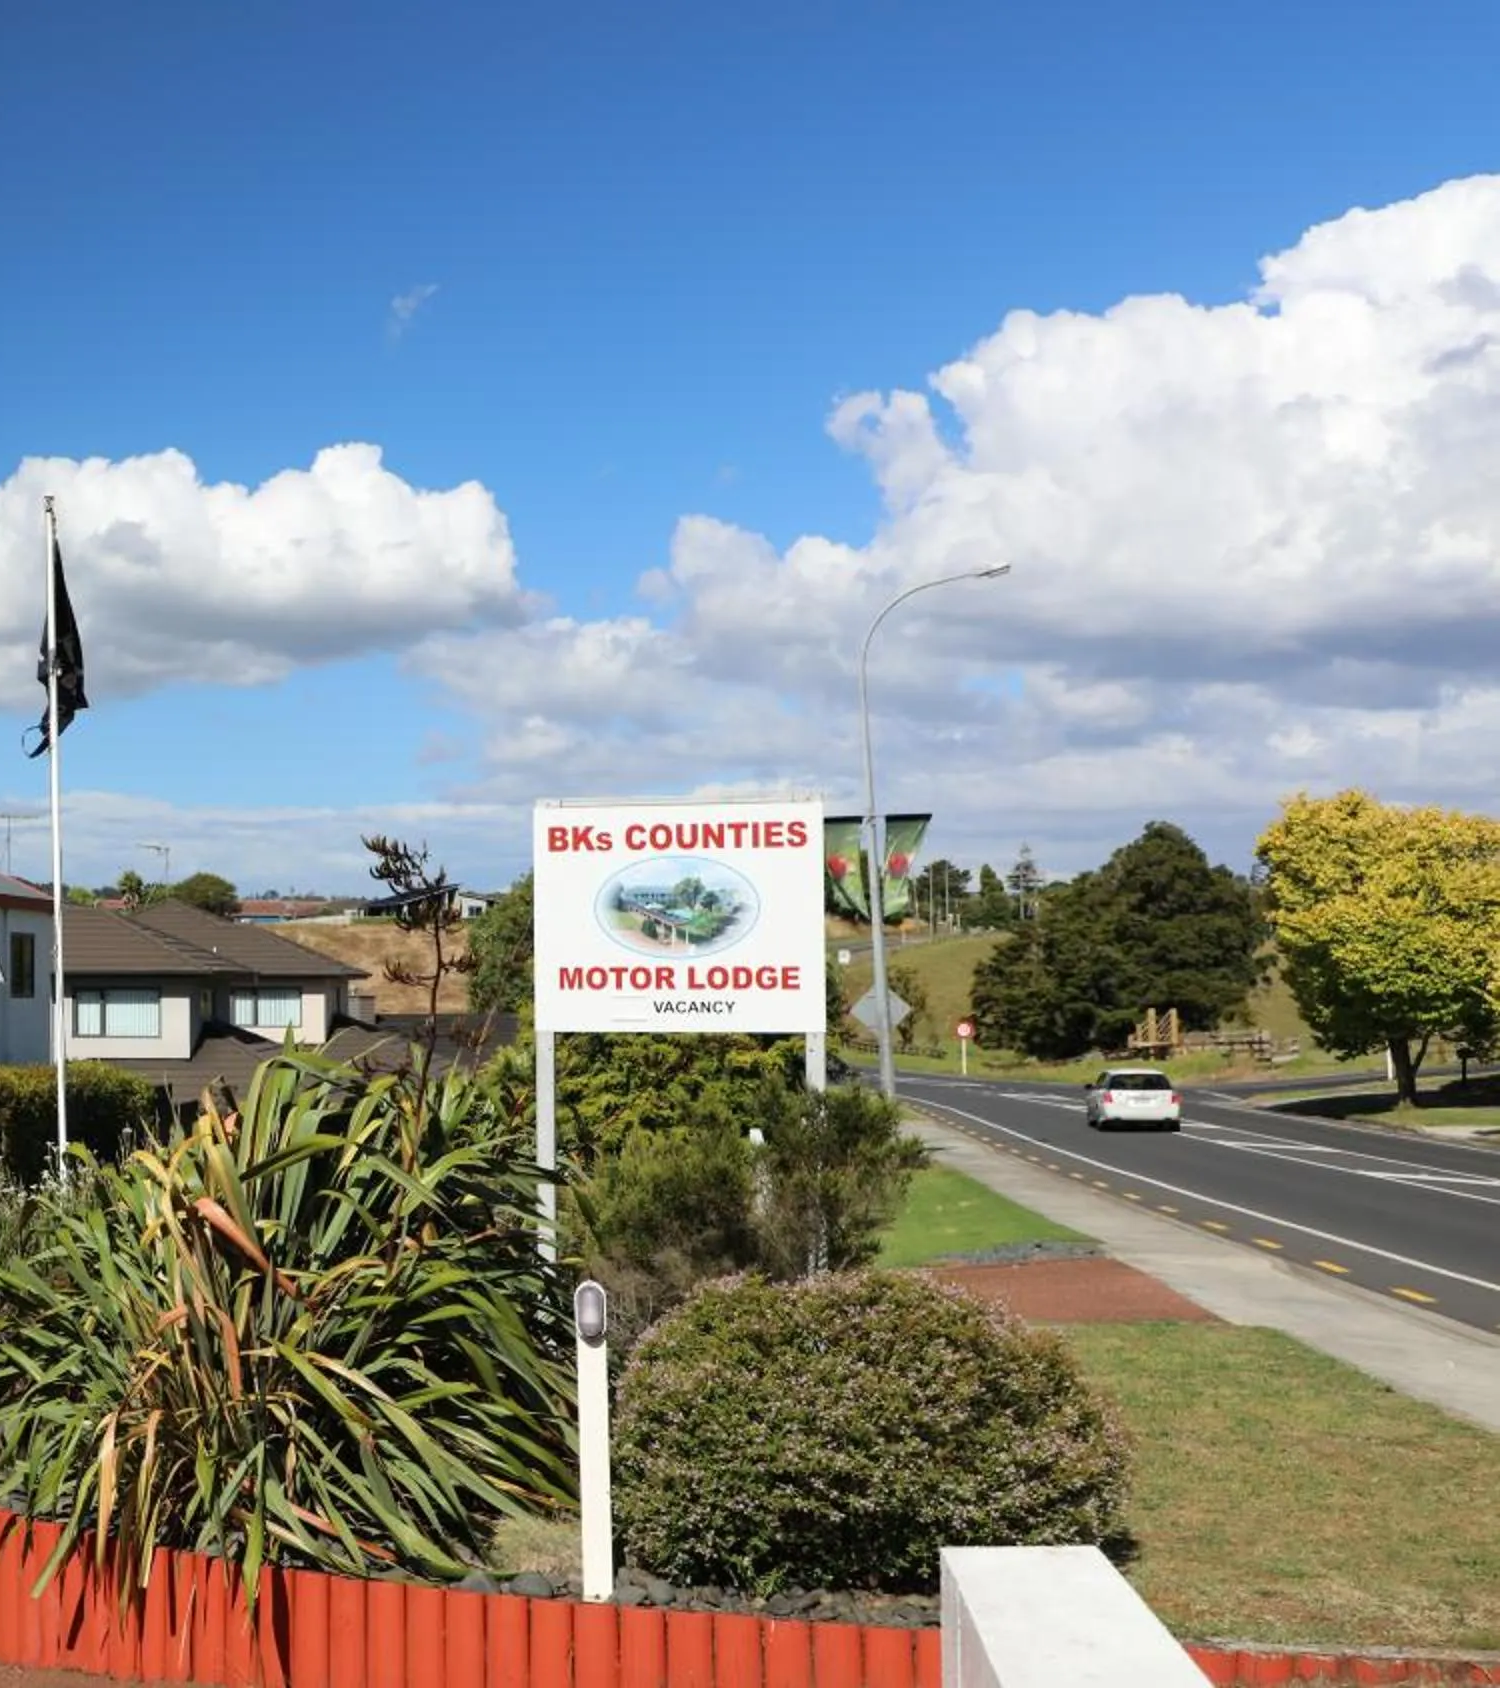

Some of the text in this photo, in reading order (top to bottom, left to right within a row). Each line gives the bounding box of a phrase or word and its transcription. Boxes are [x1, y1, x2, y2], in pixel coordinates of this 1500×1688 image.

[548, 821, 807, 852] BKs COUNTIES
[559, 966, 800, 990] MOTOR LODGE
[653, 1000, 736, 1014] VACANCY
